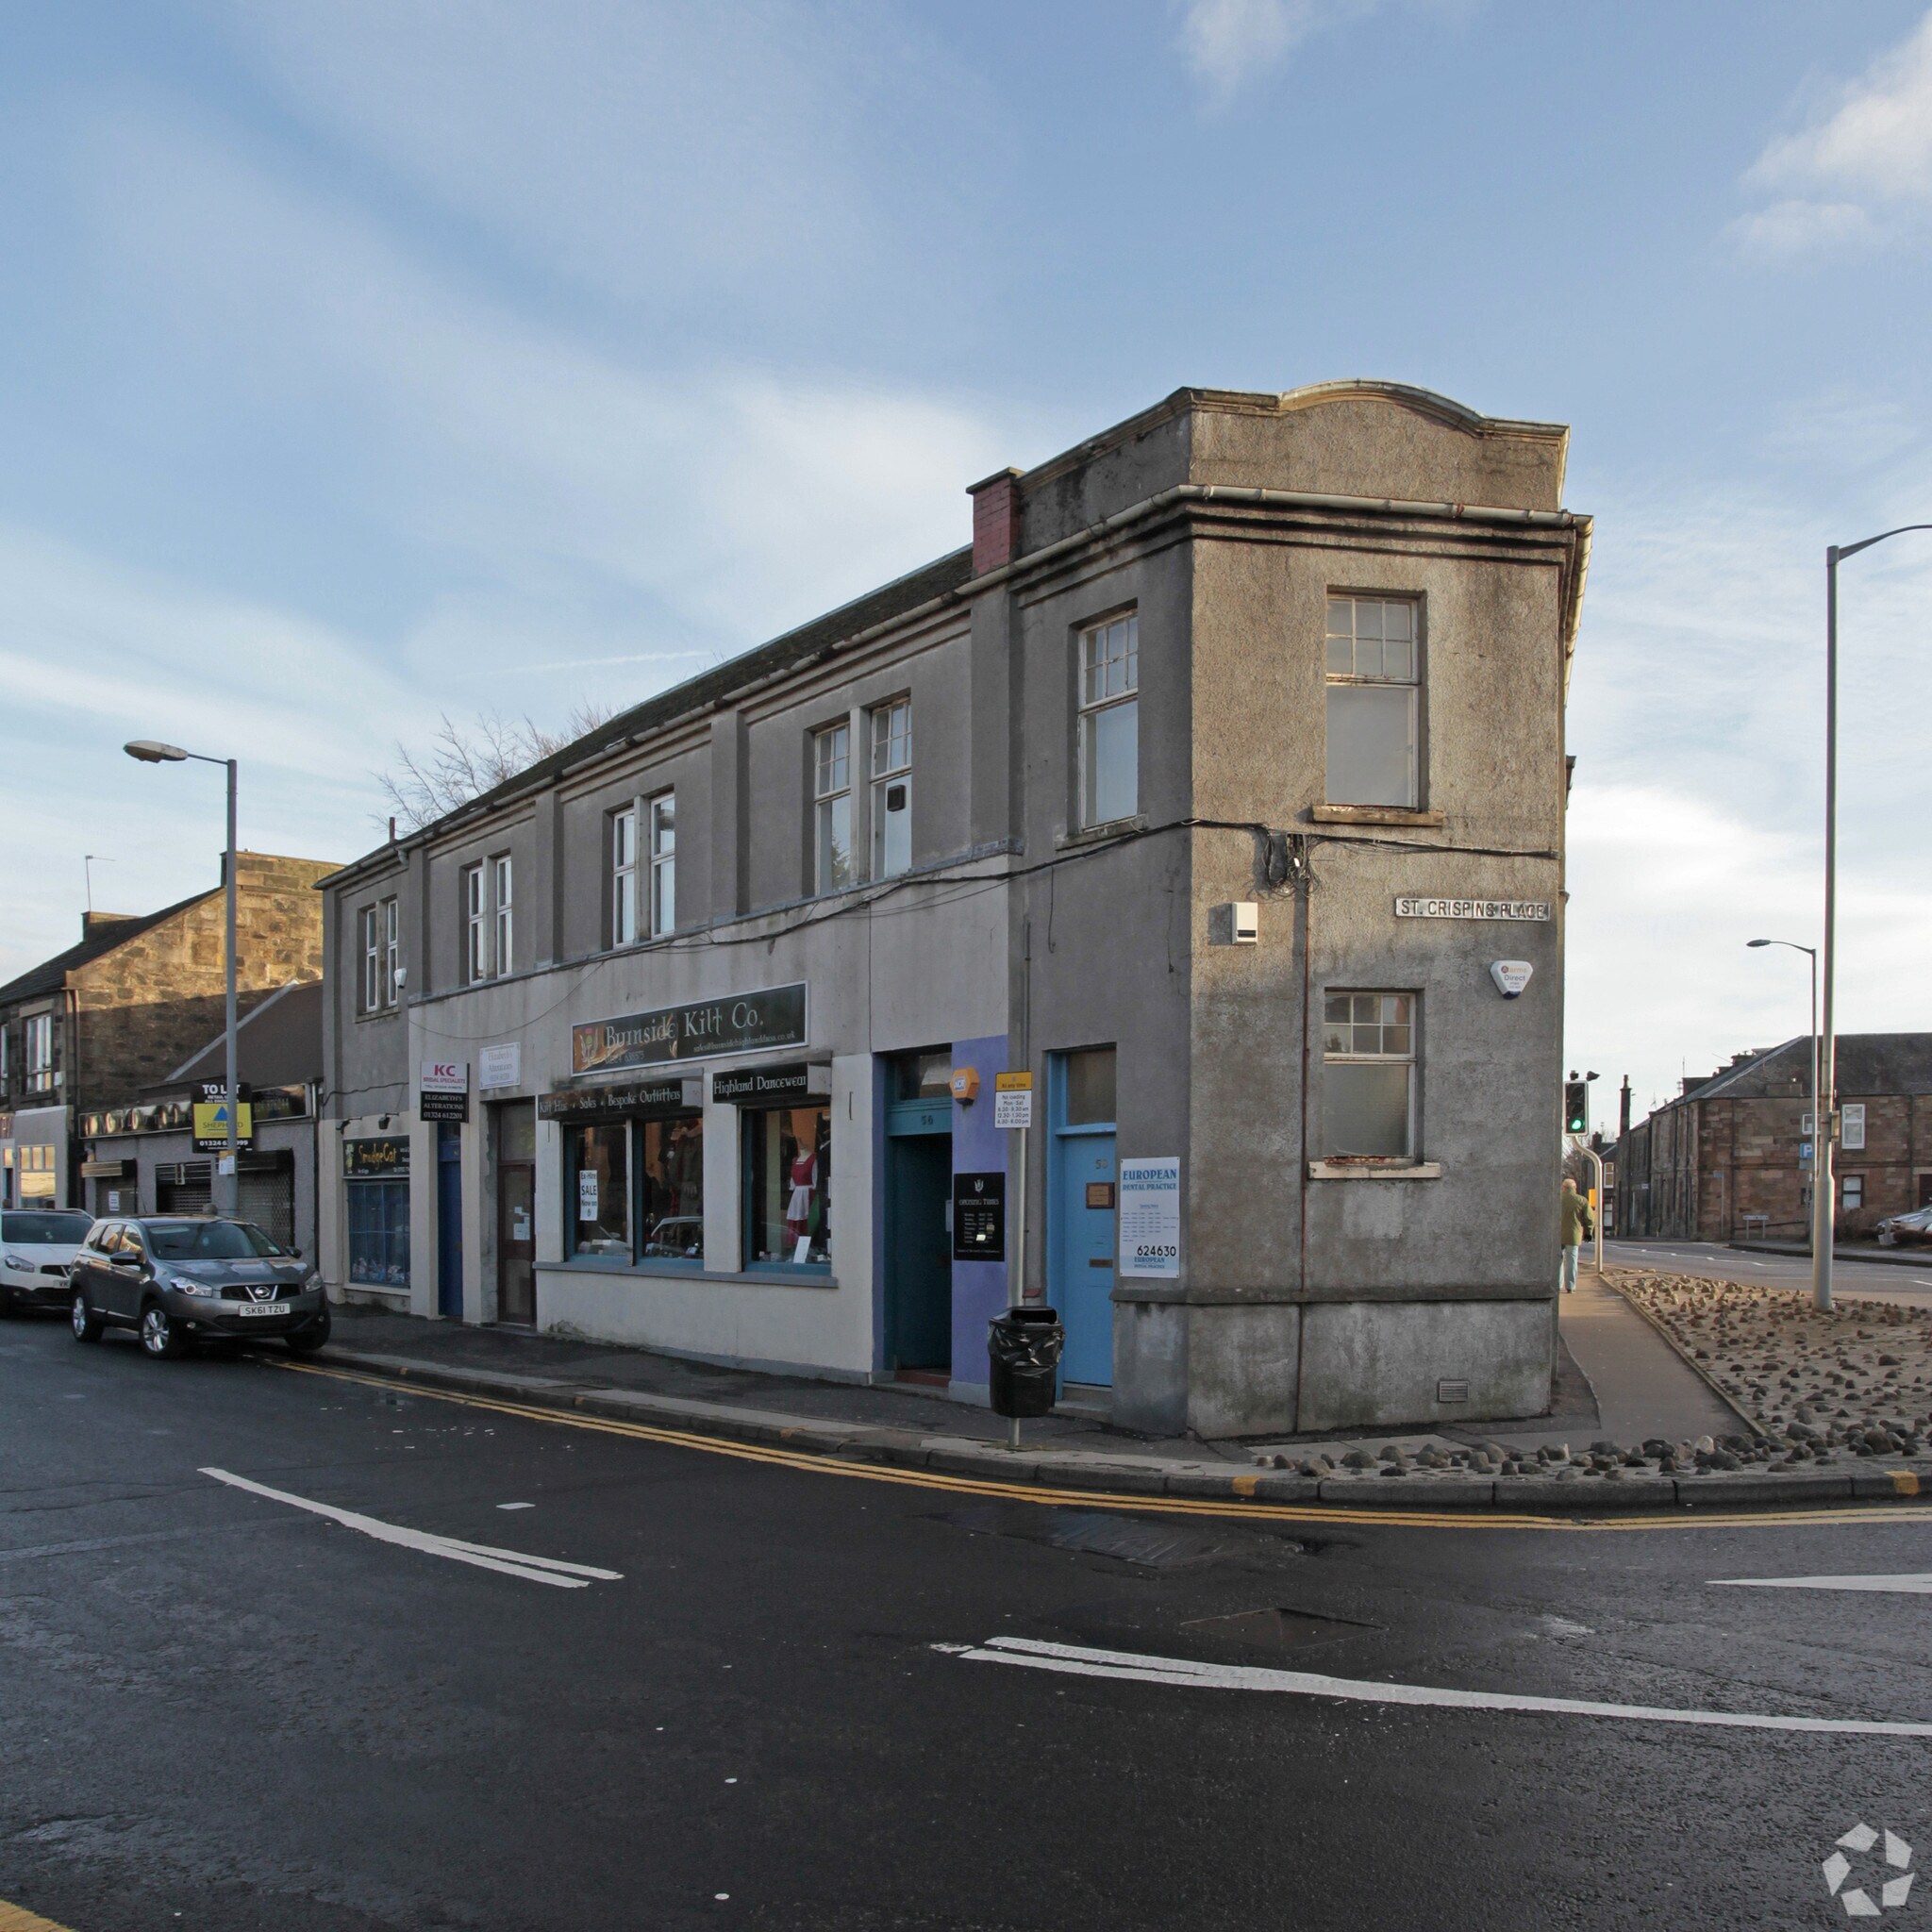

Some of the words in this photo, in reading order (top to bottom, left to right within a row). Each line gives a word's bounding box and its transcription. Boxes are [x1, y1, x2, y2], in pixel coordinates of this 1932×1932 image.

[1401, 900, 1424, 915] ST.
[1427, 901, 1496, 917] CRISPINS
[1500, 904, 1545, 920] PLACE
[605, 1016, 676, 1049] Burnside
[684, 1006, 723, 1037] Kilt
[731, 1002, 764, 1028] Co.
[434, 1064, 456, 1077] KC
[202, 1084, 219, 1094] TO
[220, 1084, 241, 1094] LT
[713, 1077, 753, 1097] Highland
[757, 1075, 806, 1090] Dancewear
[579, 1096, 596, 1109] Sales
[608, 1092, 637, 1108] Bespoke
[921, 1115, 933, 1125] 56
[1123, 1169, 1177, 1180] EUROPEAN
[581, 1185, 596, 1195] SALE
[1137, 1245, 1176, 1257] 624630
[244, 1306, 266, 1315] SK61
[268, 1305, 286, 1314] TZU
